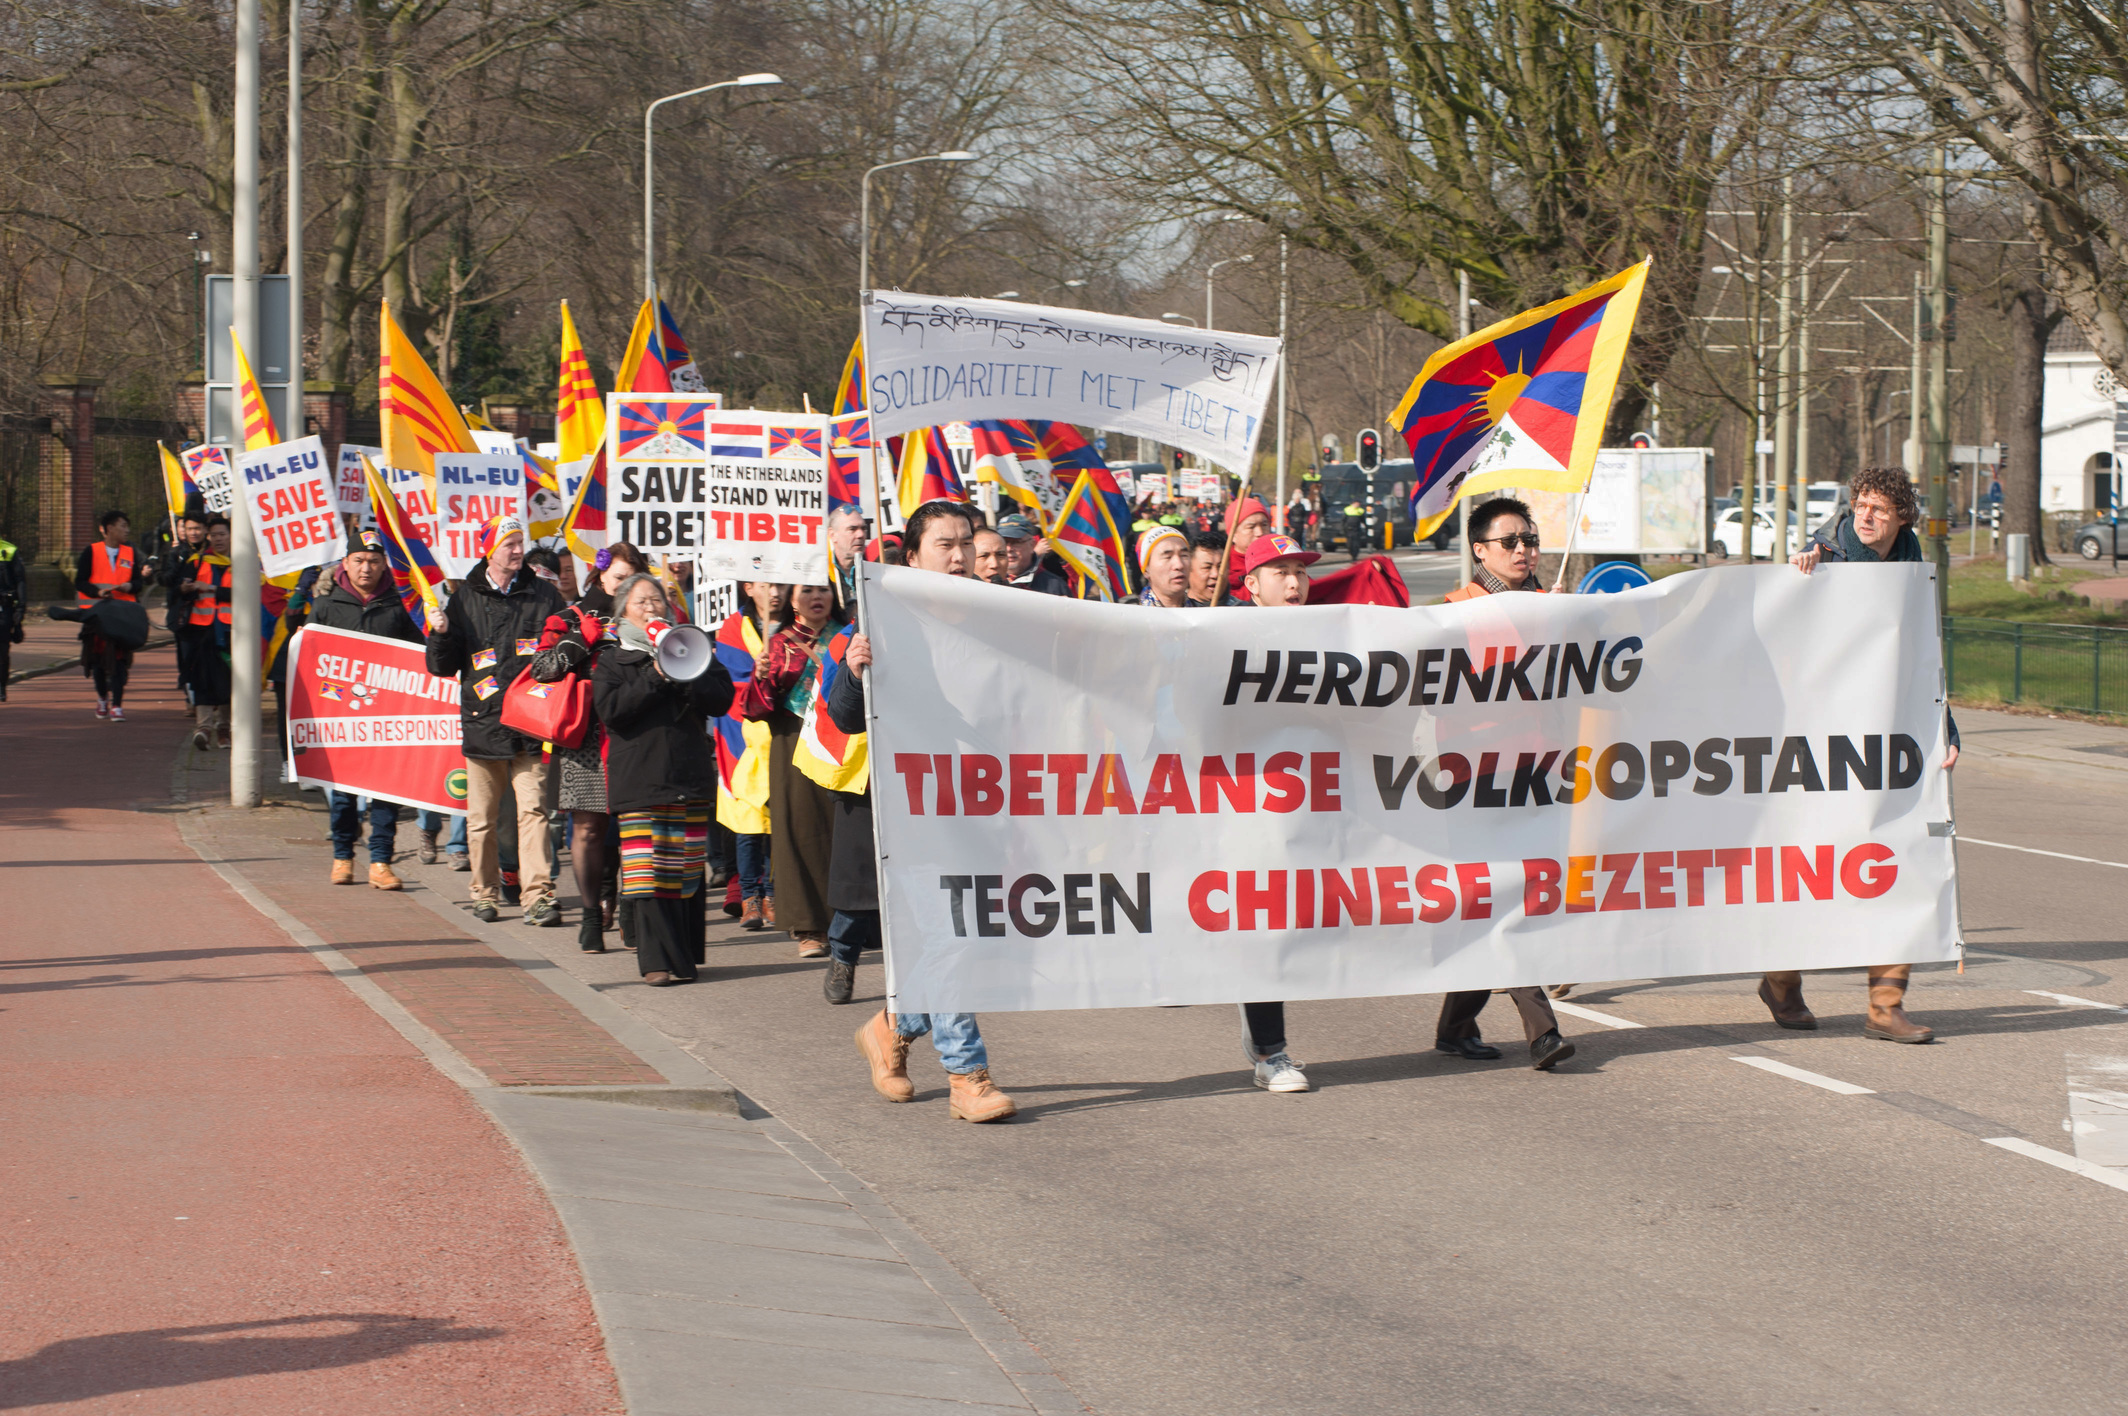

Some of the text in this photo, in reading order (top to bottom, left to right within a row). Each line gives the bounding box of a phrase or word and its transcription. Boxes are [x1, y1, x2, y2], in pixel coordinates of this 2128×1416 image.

[872, 362, 1063, 414] SOLIDARITEIT
[1081, 369, 1146, 412] MET
[197, 471, 230, 493] SAVE
[244, 450, 319, 485] NL-EU
[442, 465, 519, 486] NL-EU
[710, 464, 823, 484] THE NETHERLANDS
[257, 478, 328, 522] SAVE
[711, 485, 823, 509] STAND WITH
[261, 511, 338, 556] TIBET
[710, 510, 823, 545] TIBET
[315, 653, 365, 683] SELF
[1222, 635, 1644, 707] HERDENKING
[295, 721, 347, 744] CHINA
[352, 721, 367, 742] IS
[894, 733, 1924, 817] TIBETAANSE VOLKSOPSTAND
[939, 842, 1899, 939] TEGEN CHINESE BEZETTING
